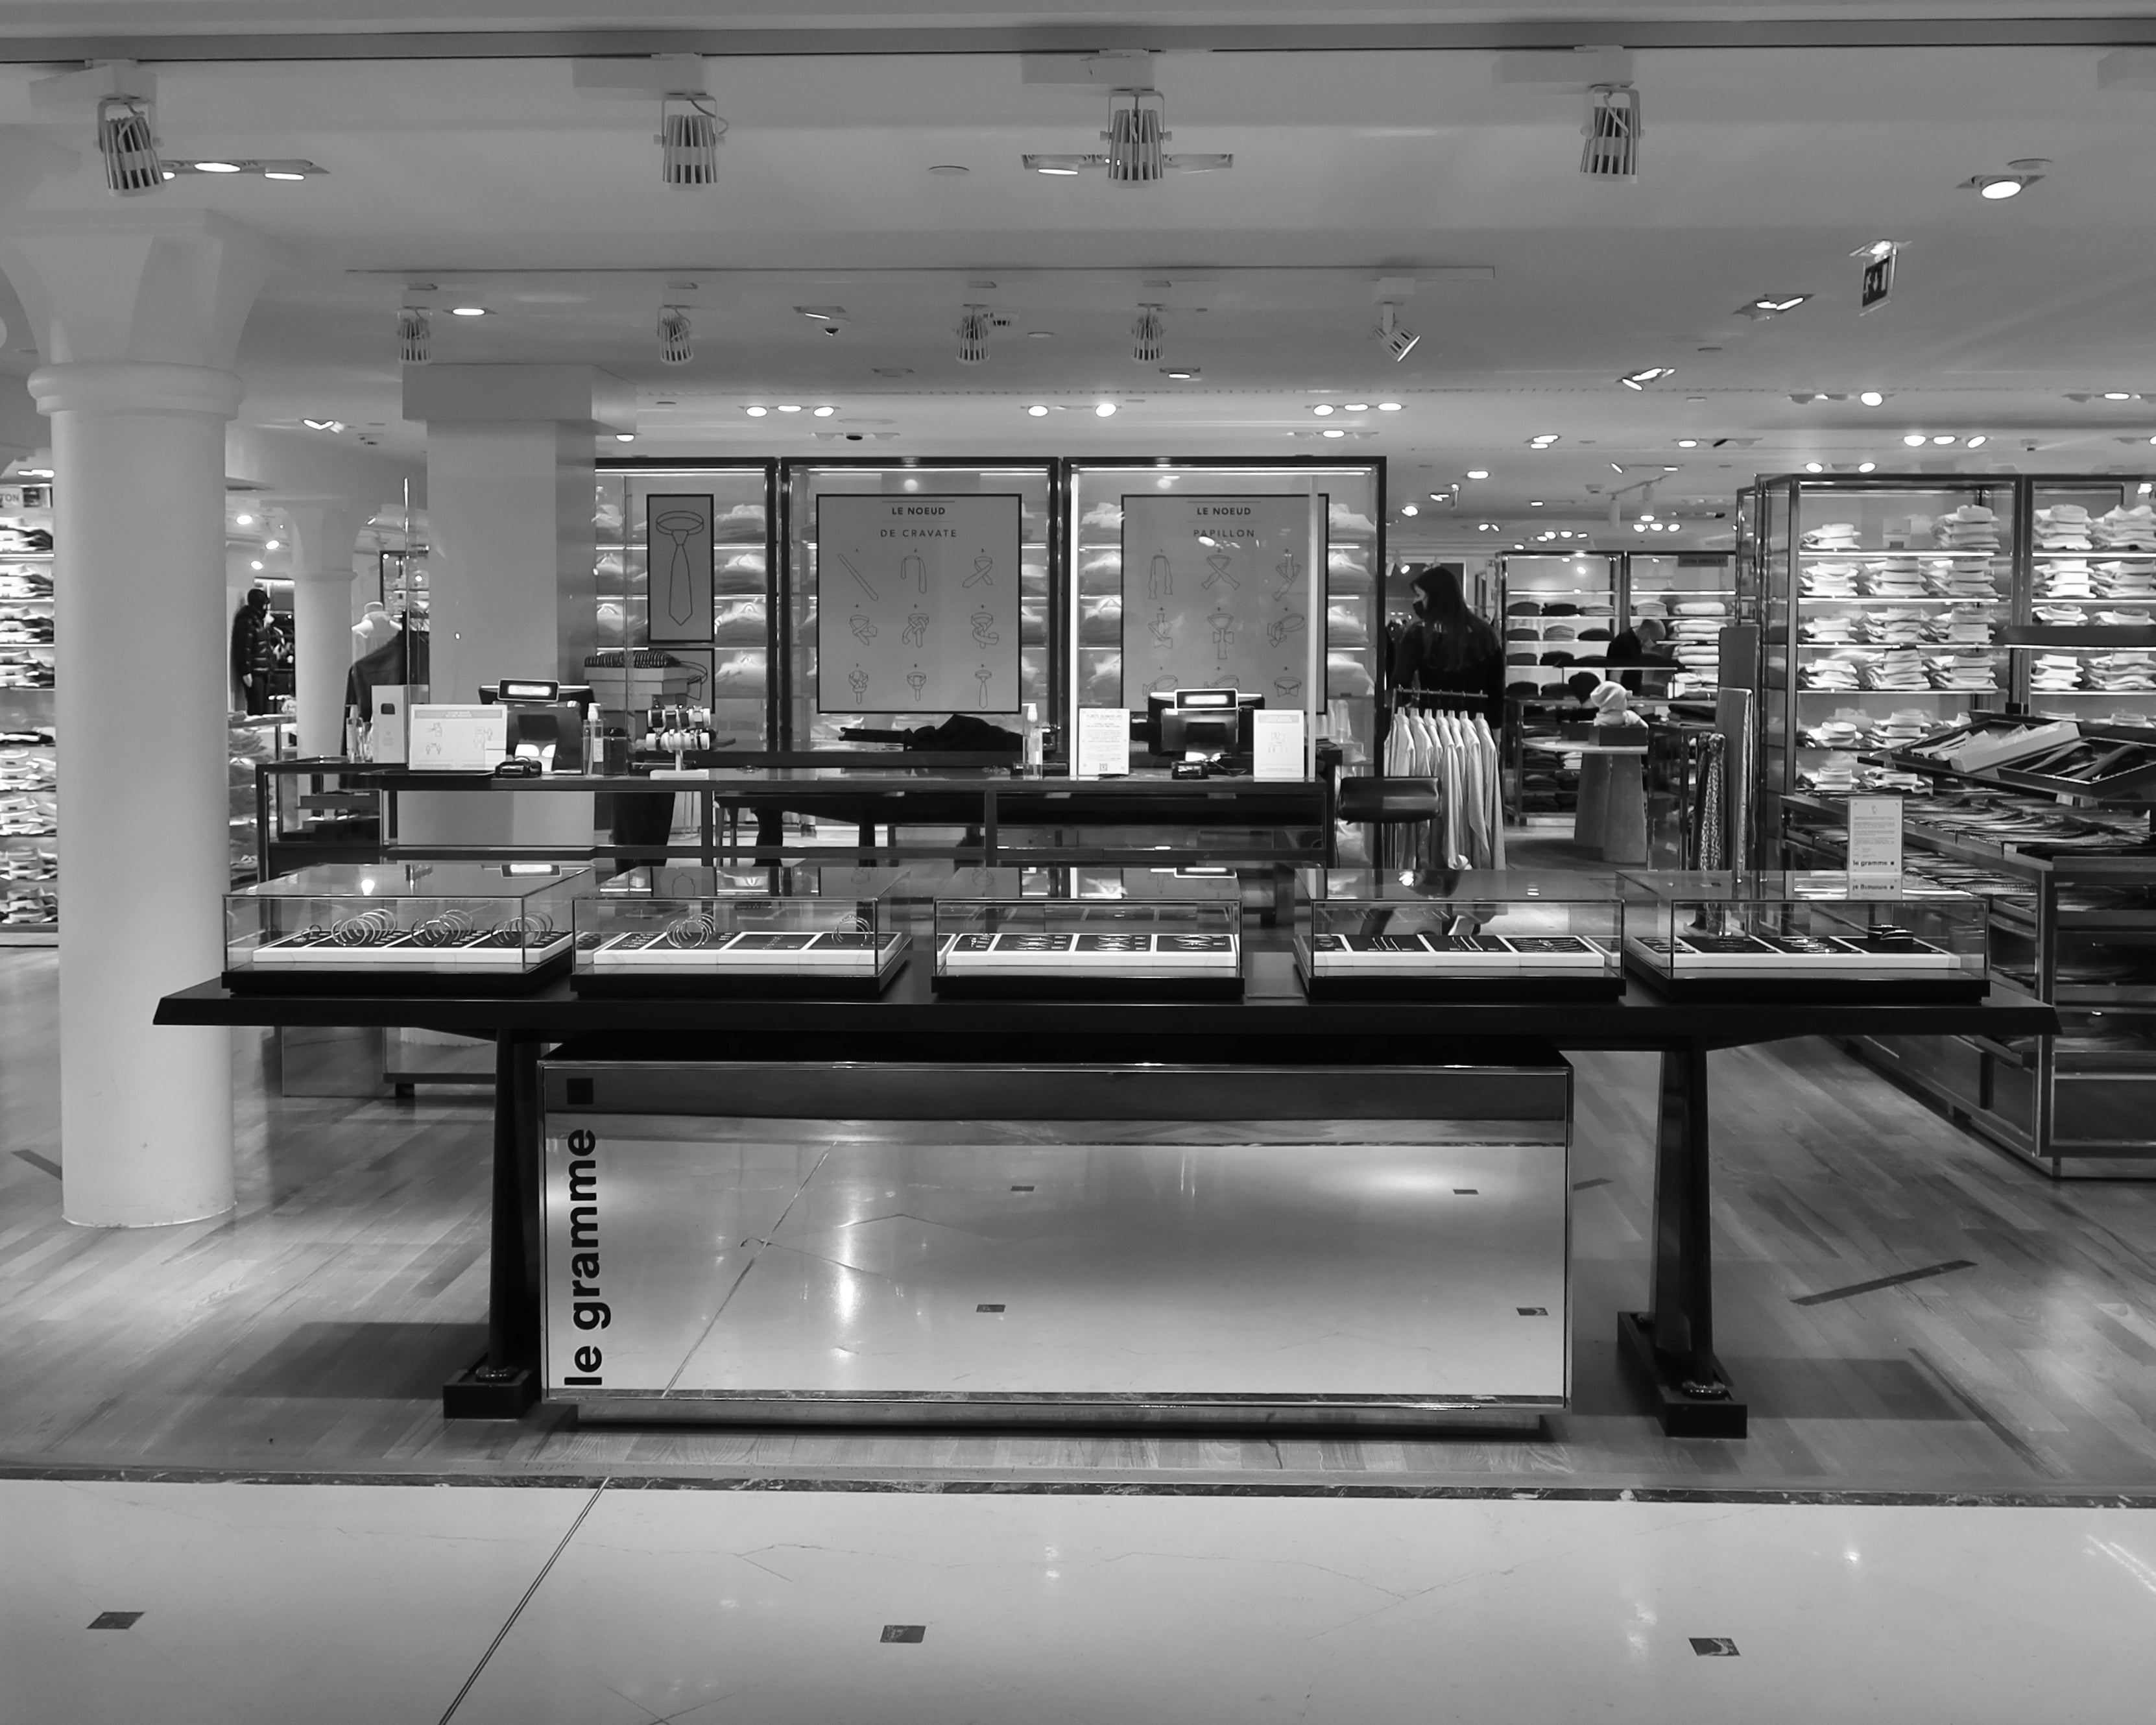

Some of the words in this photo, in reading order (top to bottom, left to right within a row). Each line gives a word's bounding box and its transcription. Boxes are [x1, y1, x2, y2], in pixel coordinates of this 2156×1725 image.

[892, 507, 904, 515] LE
[907, 507, 946, 515] NOEUD
[1197, 507, 1208, 515] LE
[1212, 507, 1251, 515] NOEUD
[880, 529, 896, 537] DE
[902, 529, 957, 537] CRAVATE
[1193, 529, 1255, 537] PAPILLON
[568, 1129, 612, 1331] gramme
[564, 1345, 603, 1386] le
